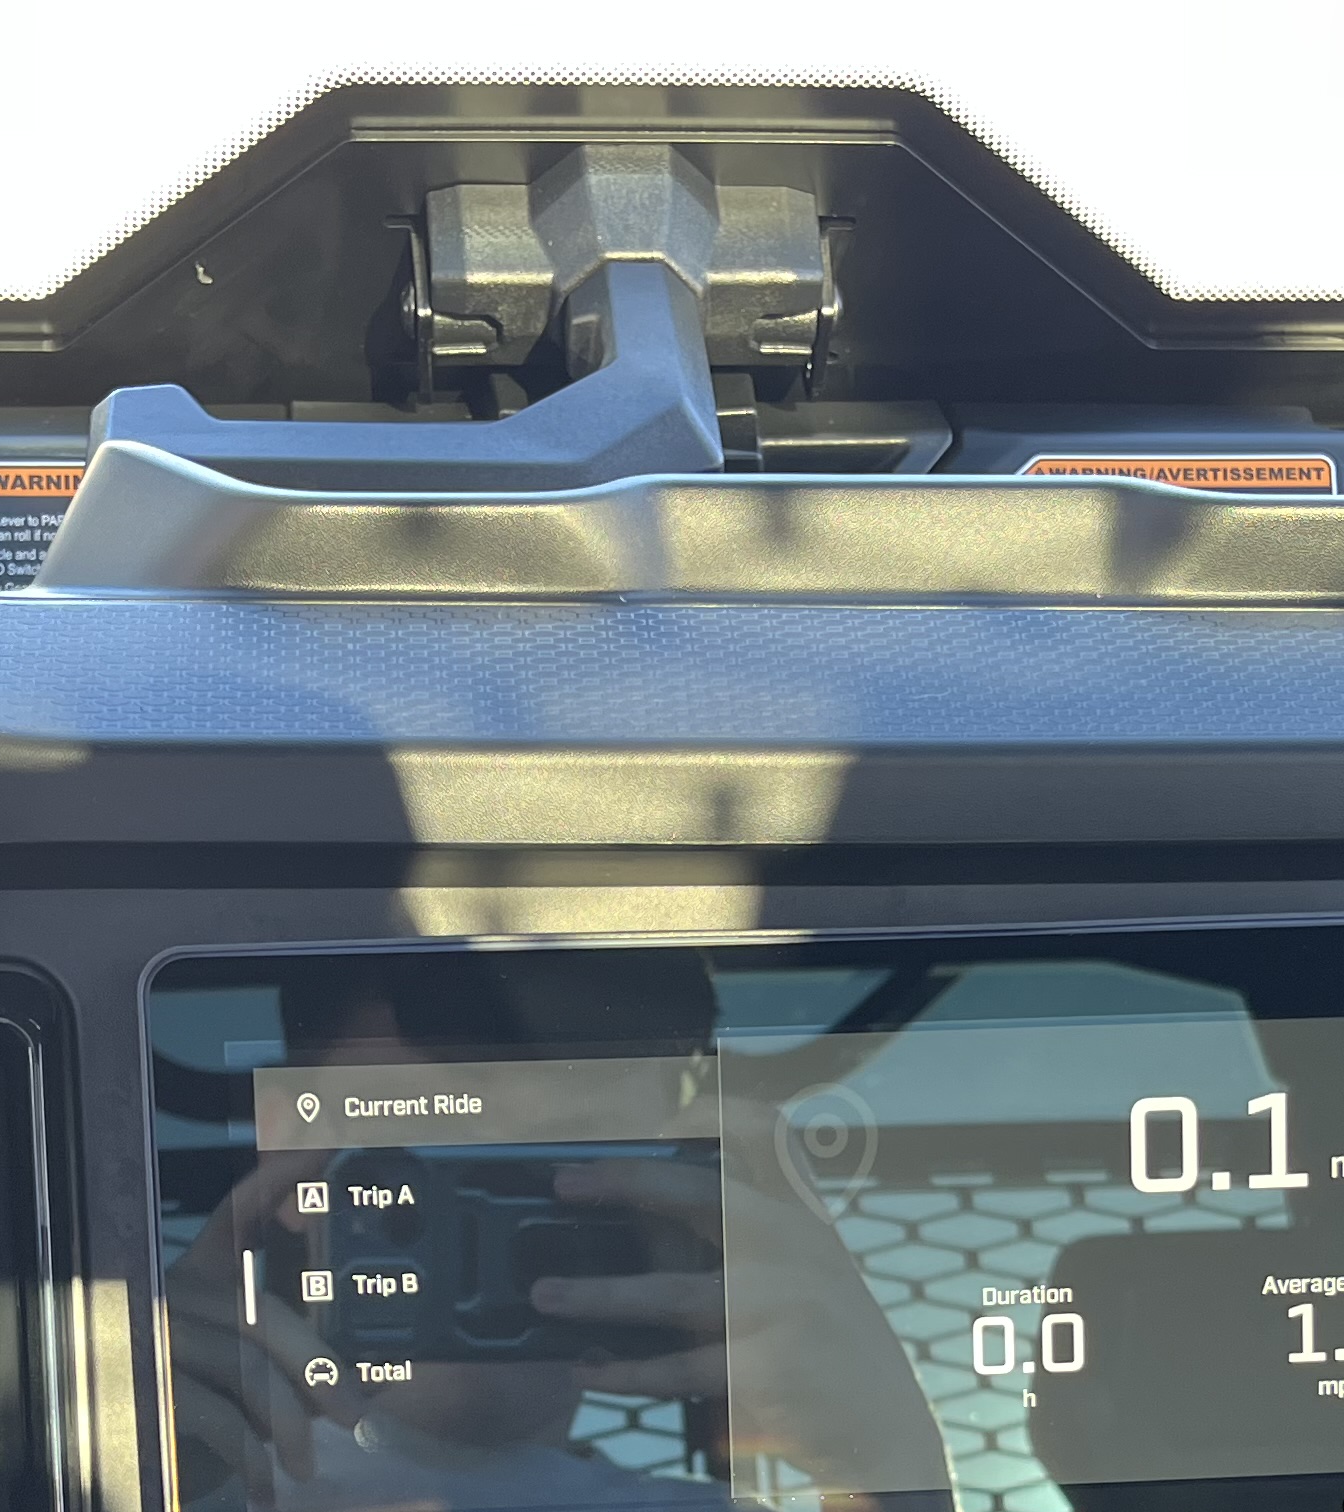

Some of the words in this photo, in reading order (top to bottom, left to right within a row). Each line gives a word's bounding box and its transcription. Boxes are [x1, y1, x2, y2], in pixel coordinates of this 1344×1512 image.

[27, 514, 39, 527] to
[14, 529, 32, 542] roll
[33, 529, 42, 542] if
[15, 548, 36, 560] and
[345, 1097, 428, 1116] Current
[434, 1094, 481, 1114] Ride
[1131, 1093, 1308, 1192] 0.1
[347, 1185, 394, 1209] Trip
[397, 1184, 415, 1205] A
[351, 1273, 397, 1297] Trip
[401, 1272, 419, 1293] B
[983, 1285, 1071, 1305] Duration
[973, 1314, 1084, 1375] 0.0
[356, 1360, 411, 1381] Total
[1023, 1389, 1036, 1407] h
